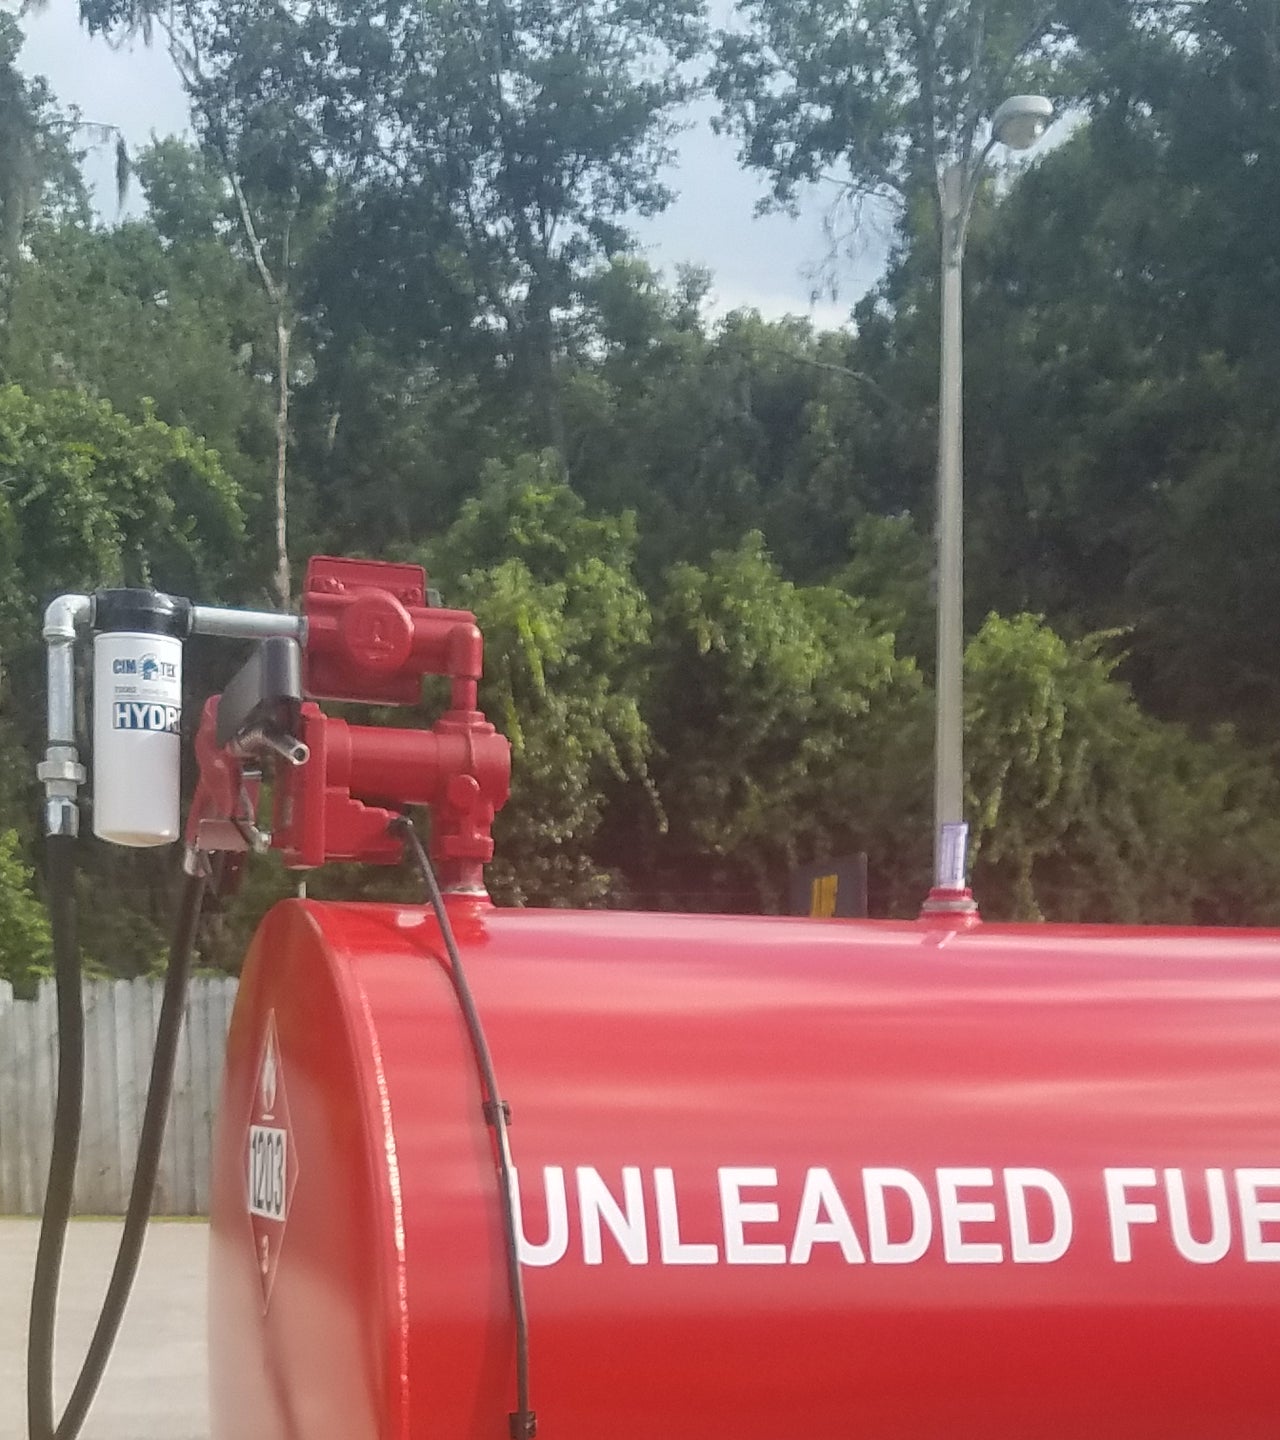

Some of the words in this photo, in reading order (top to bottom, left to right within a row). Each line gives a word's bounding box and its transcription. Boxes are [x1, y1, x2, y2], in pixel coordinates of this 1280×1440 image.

[113, 659, 137, 674] CIM
[115, 703, 181, 732] HYDR
[252, 1131, 284, 1215] 1203
[510, 1166, 1073, 1266] UNLEADED
